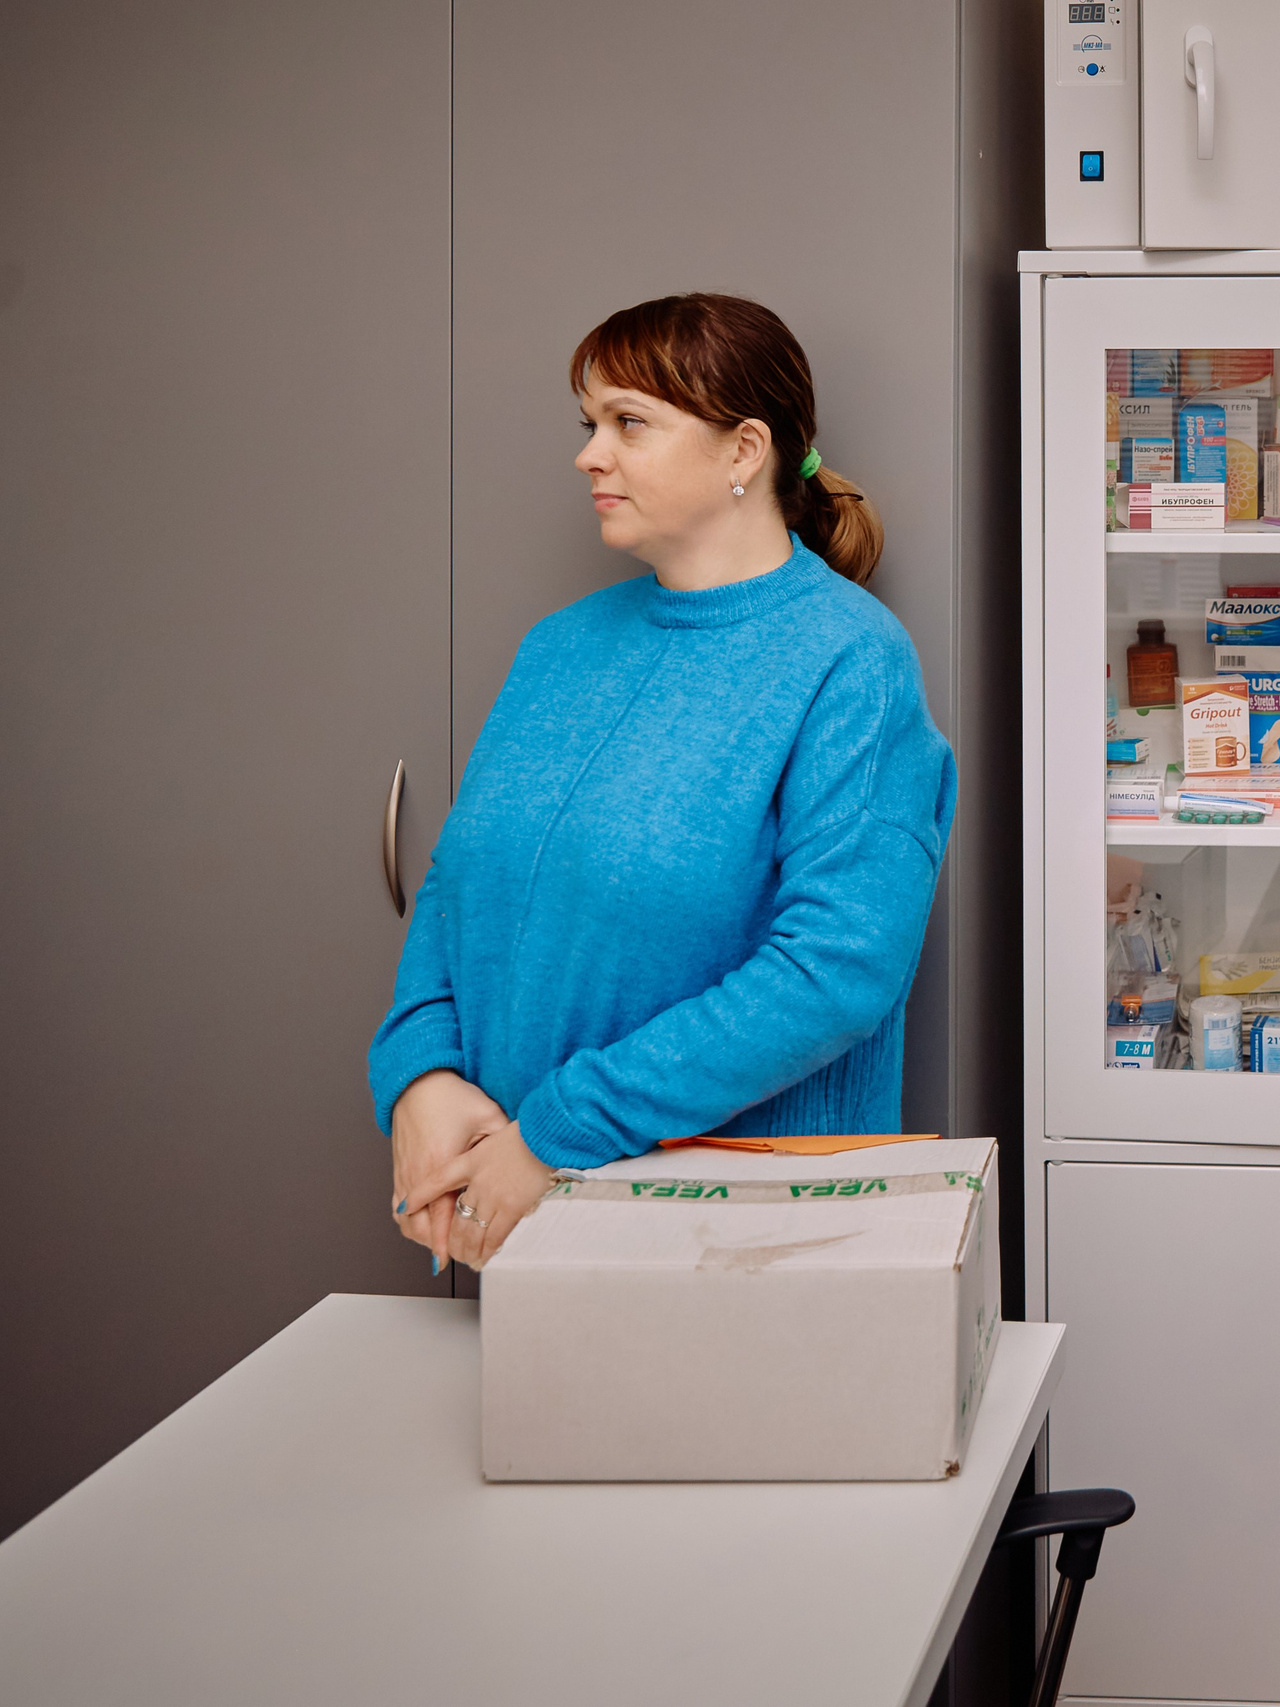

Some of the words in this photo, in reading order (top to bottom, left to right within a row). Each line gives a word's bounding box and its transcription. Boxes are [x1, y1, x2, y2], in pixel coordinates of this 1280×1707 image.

[1134, 445, 1173, 454] Назо-спрей
[1190, 707, 1242, 721] Gripout
[1109, 793, 1156, 801] НІМЕСУЛІД
[1123, 1043, 1140, 1055] 7-8
[1141, 1043, 1151, 1055] M
[630, 1182, 729, 1199] VEFA
[790, 1179, 888, 1198] VEFA
